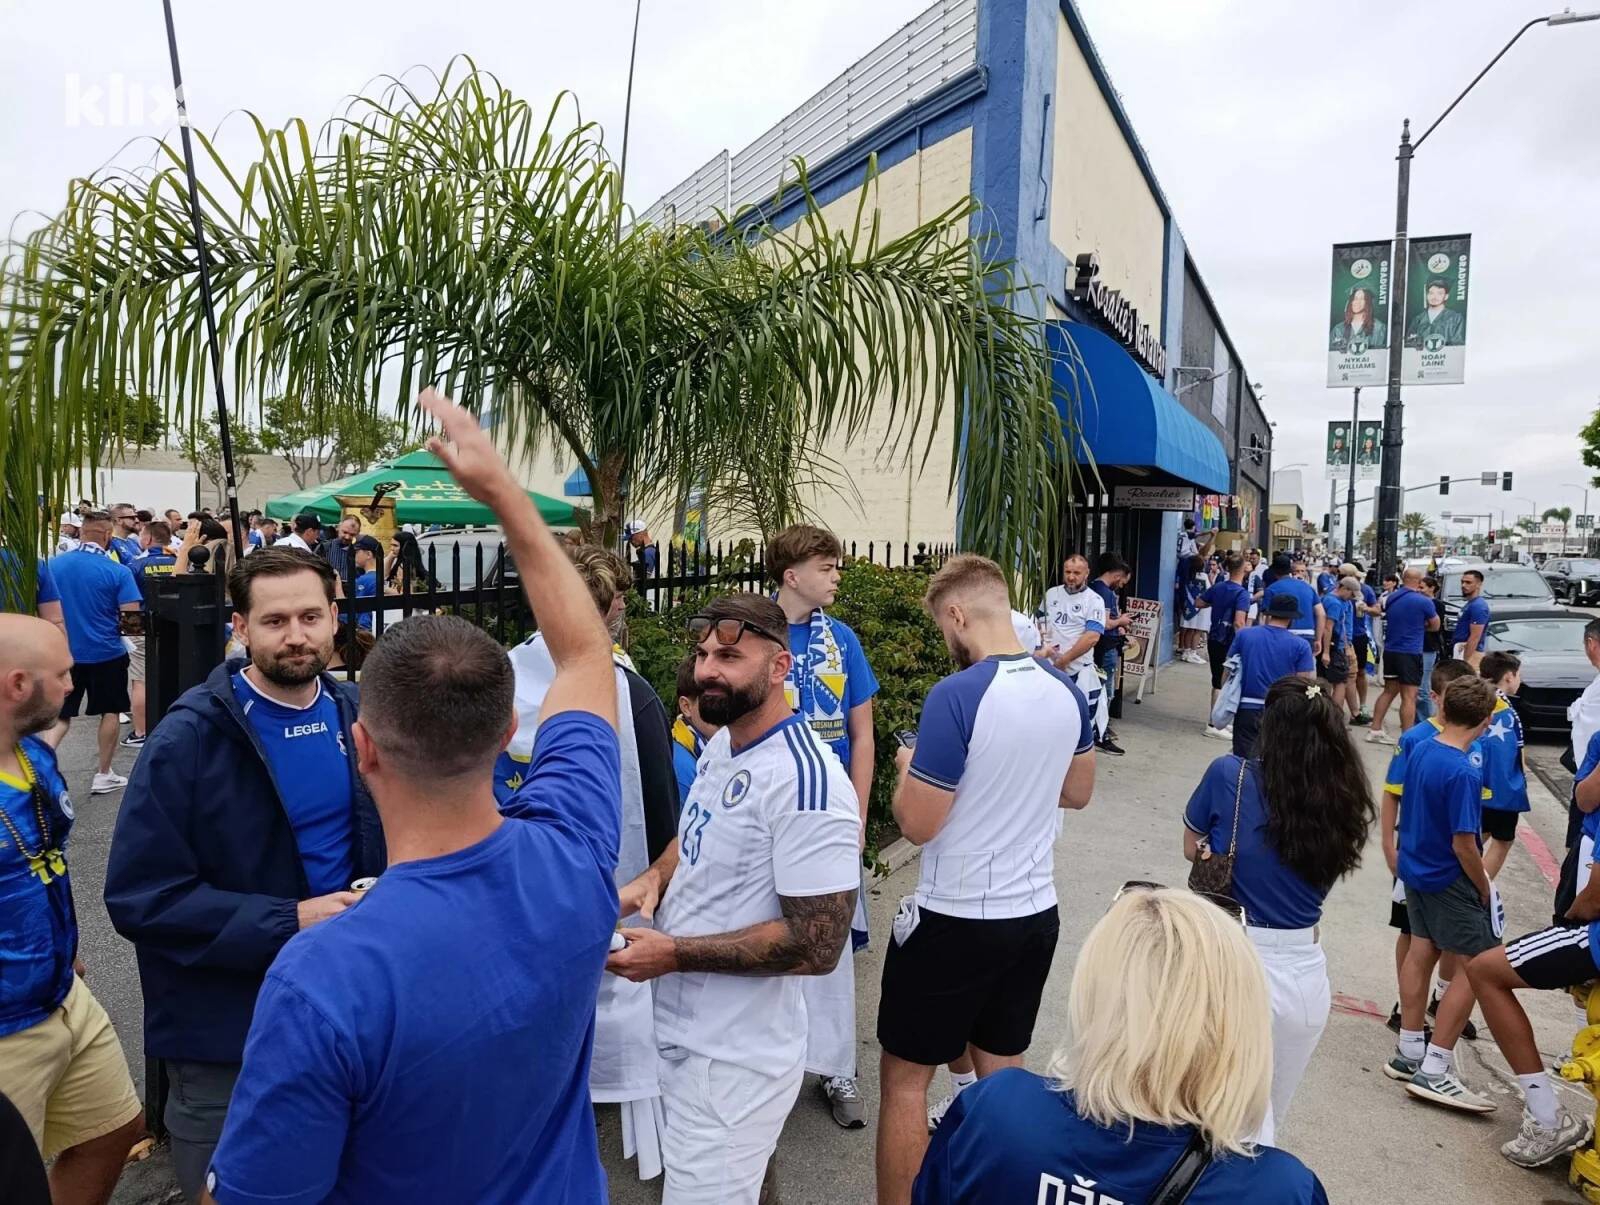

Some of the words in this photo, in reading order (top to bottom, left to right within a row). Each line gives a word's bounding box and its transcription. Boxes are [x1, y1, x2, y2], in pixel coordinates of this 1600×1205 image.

[1379, 260, 1389, 305] GRADUATE
[1456, 254, 1468, 301] GRADUATE
[1338, 362, 1376, 370] WILLIAMS
[1054, 611, 1068, 625] 20
[284, 721, 329, 739] LEGEA
[681, 801, 712, 867] 23
